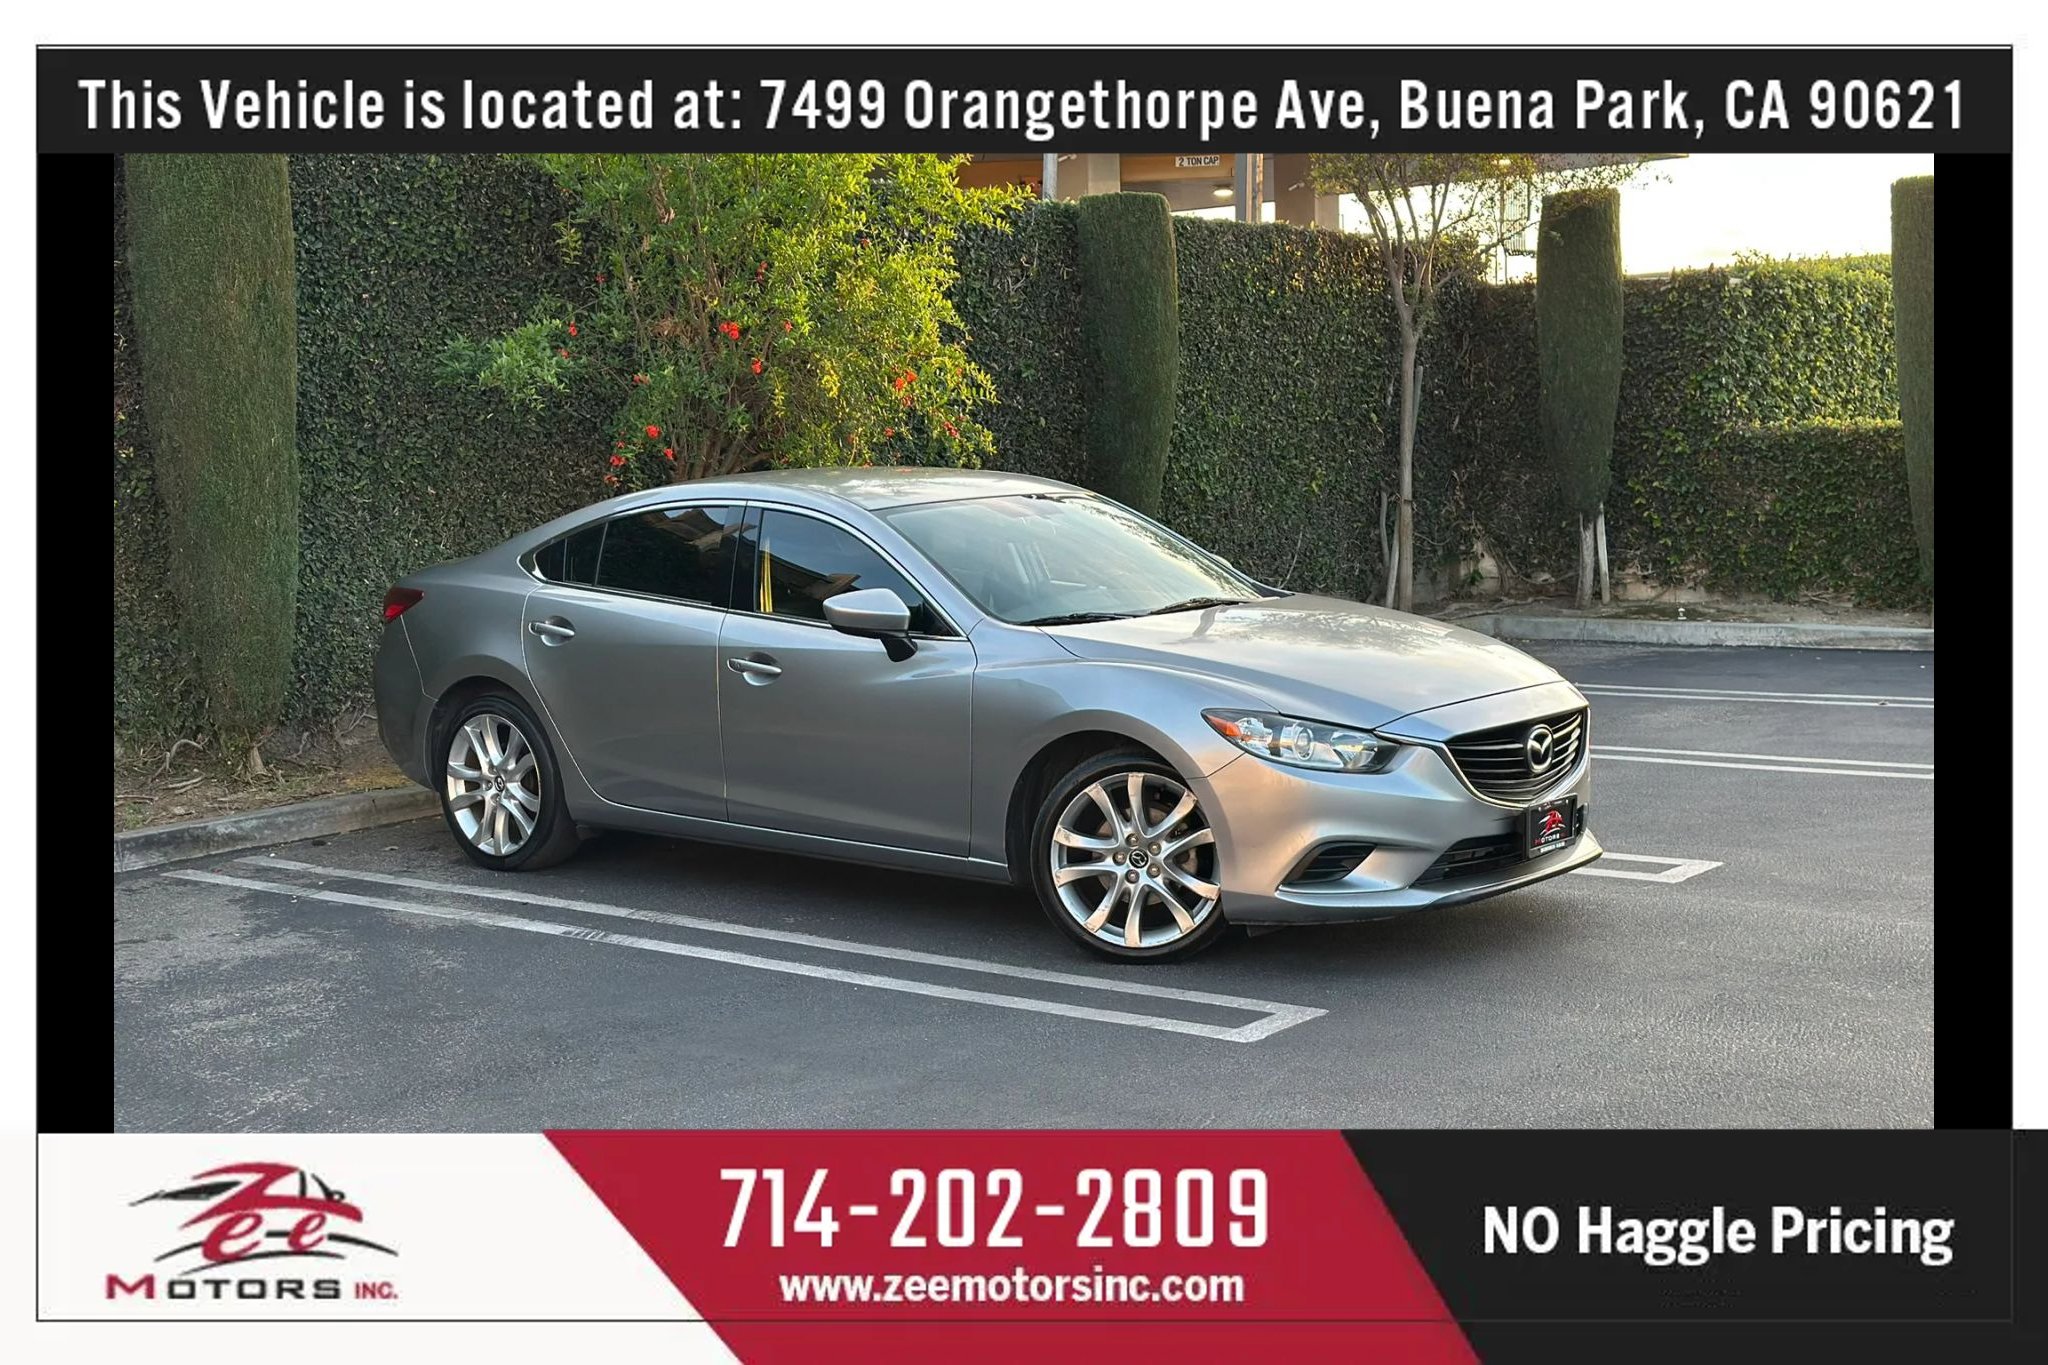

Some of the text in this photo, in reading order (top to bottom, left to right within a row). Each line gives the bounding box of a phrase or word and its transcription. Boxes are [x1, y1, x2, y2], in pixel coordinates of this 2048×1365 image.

[1179, 156, 1219, 167] 2 TON CAP
